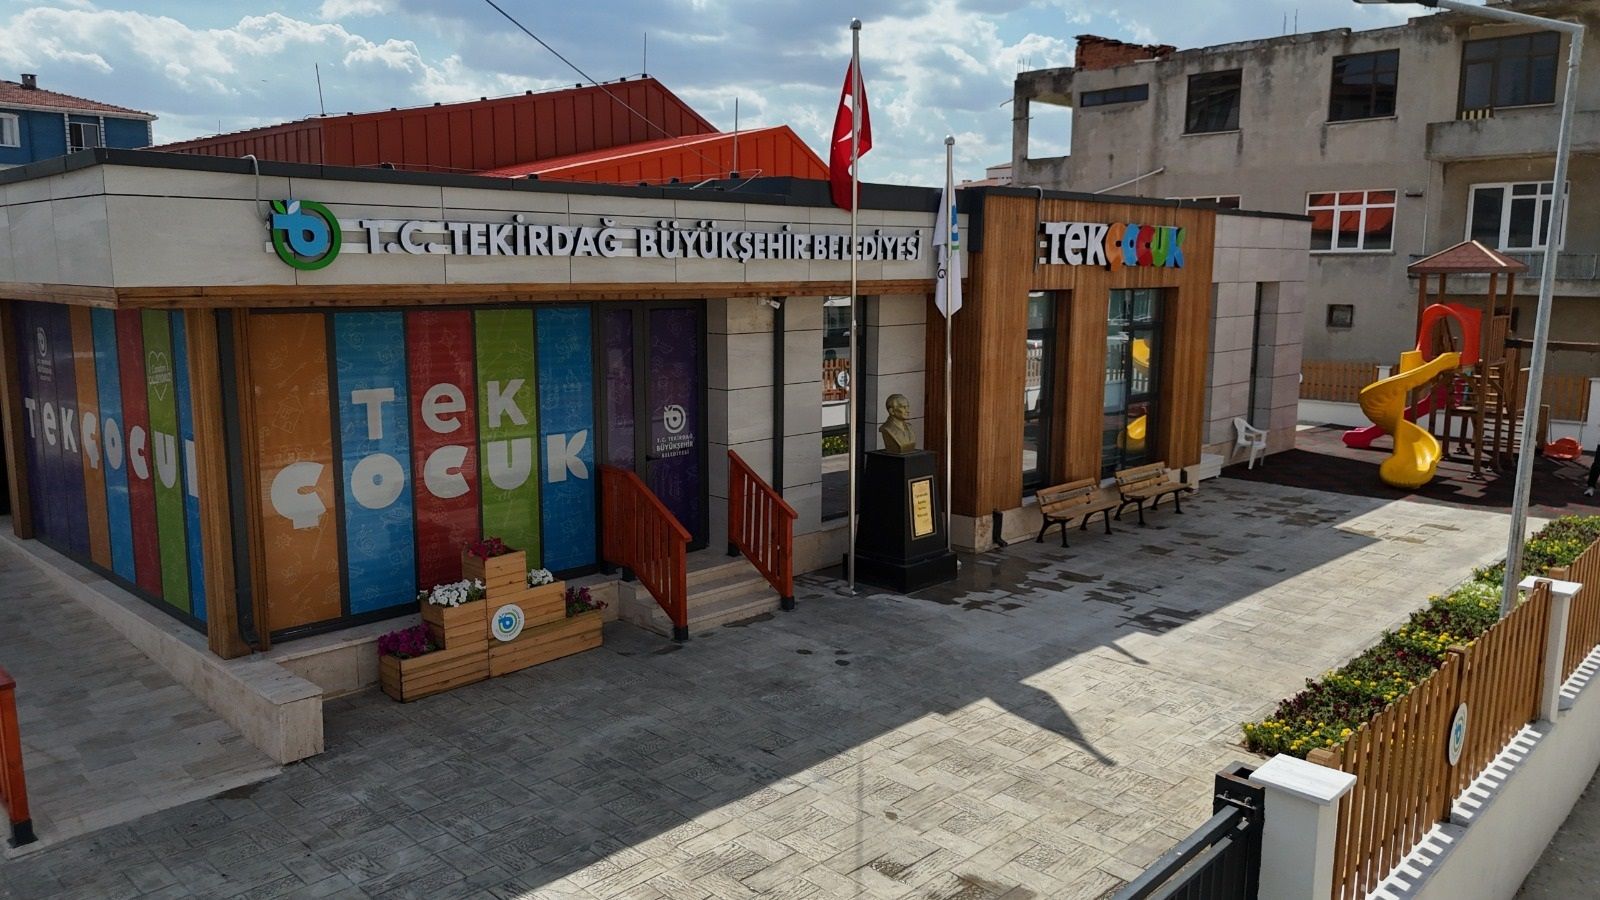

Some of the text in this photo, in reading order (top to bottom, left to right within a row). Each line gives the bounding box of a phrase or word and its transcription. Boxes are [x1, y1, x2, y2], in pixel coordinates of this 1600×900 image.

[358, 214, 923, 264] T.C. TEKİRDAĞ BÜYÜKŞEHİR BELEDİYESİ
[271, 429, 589, 530] ÇOCUK
